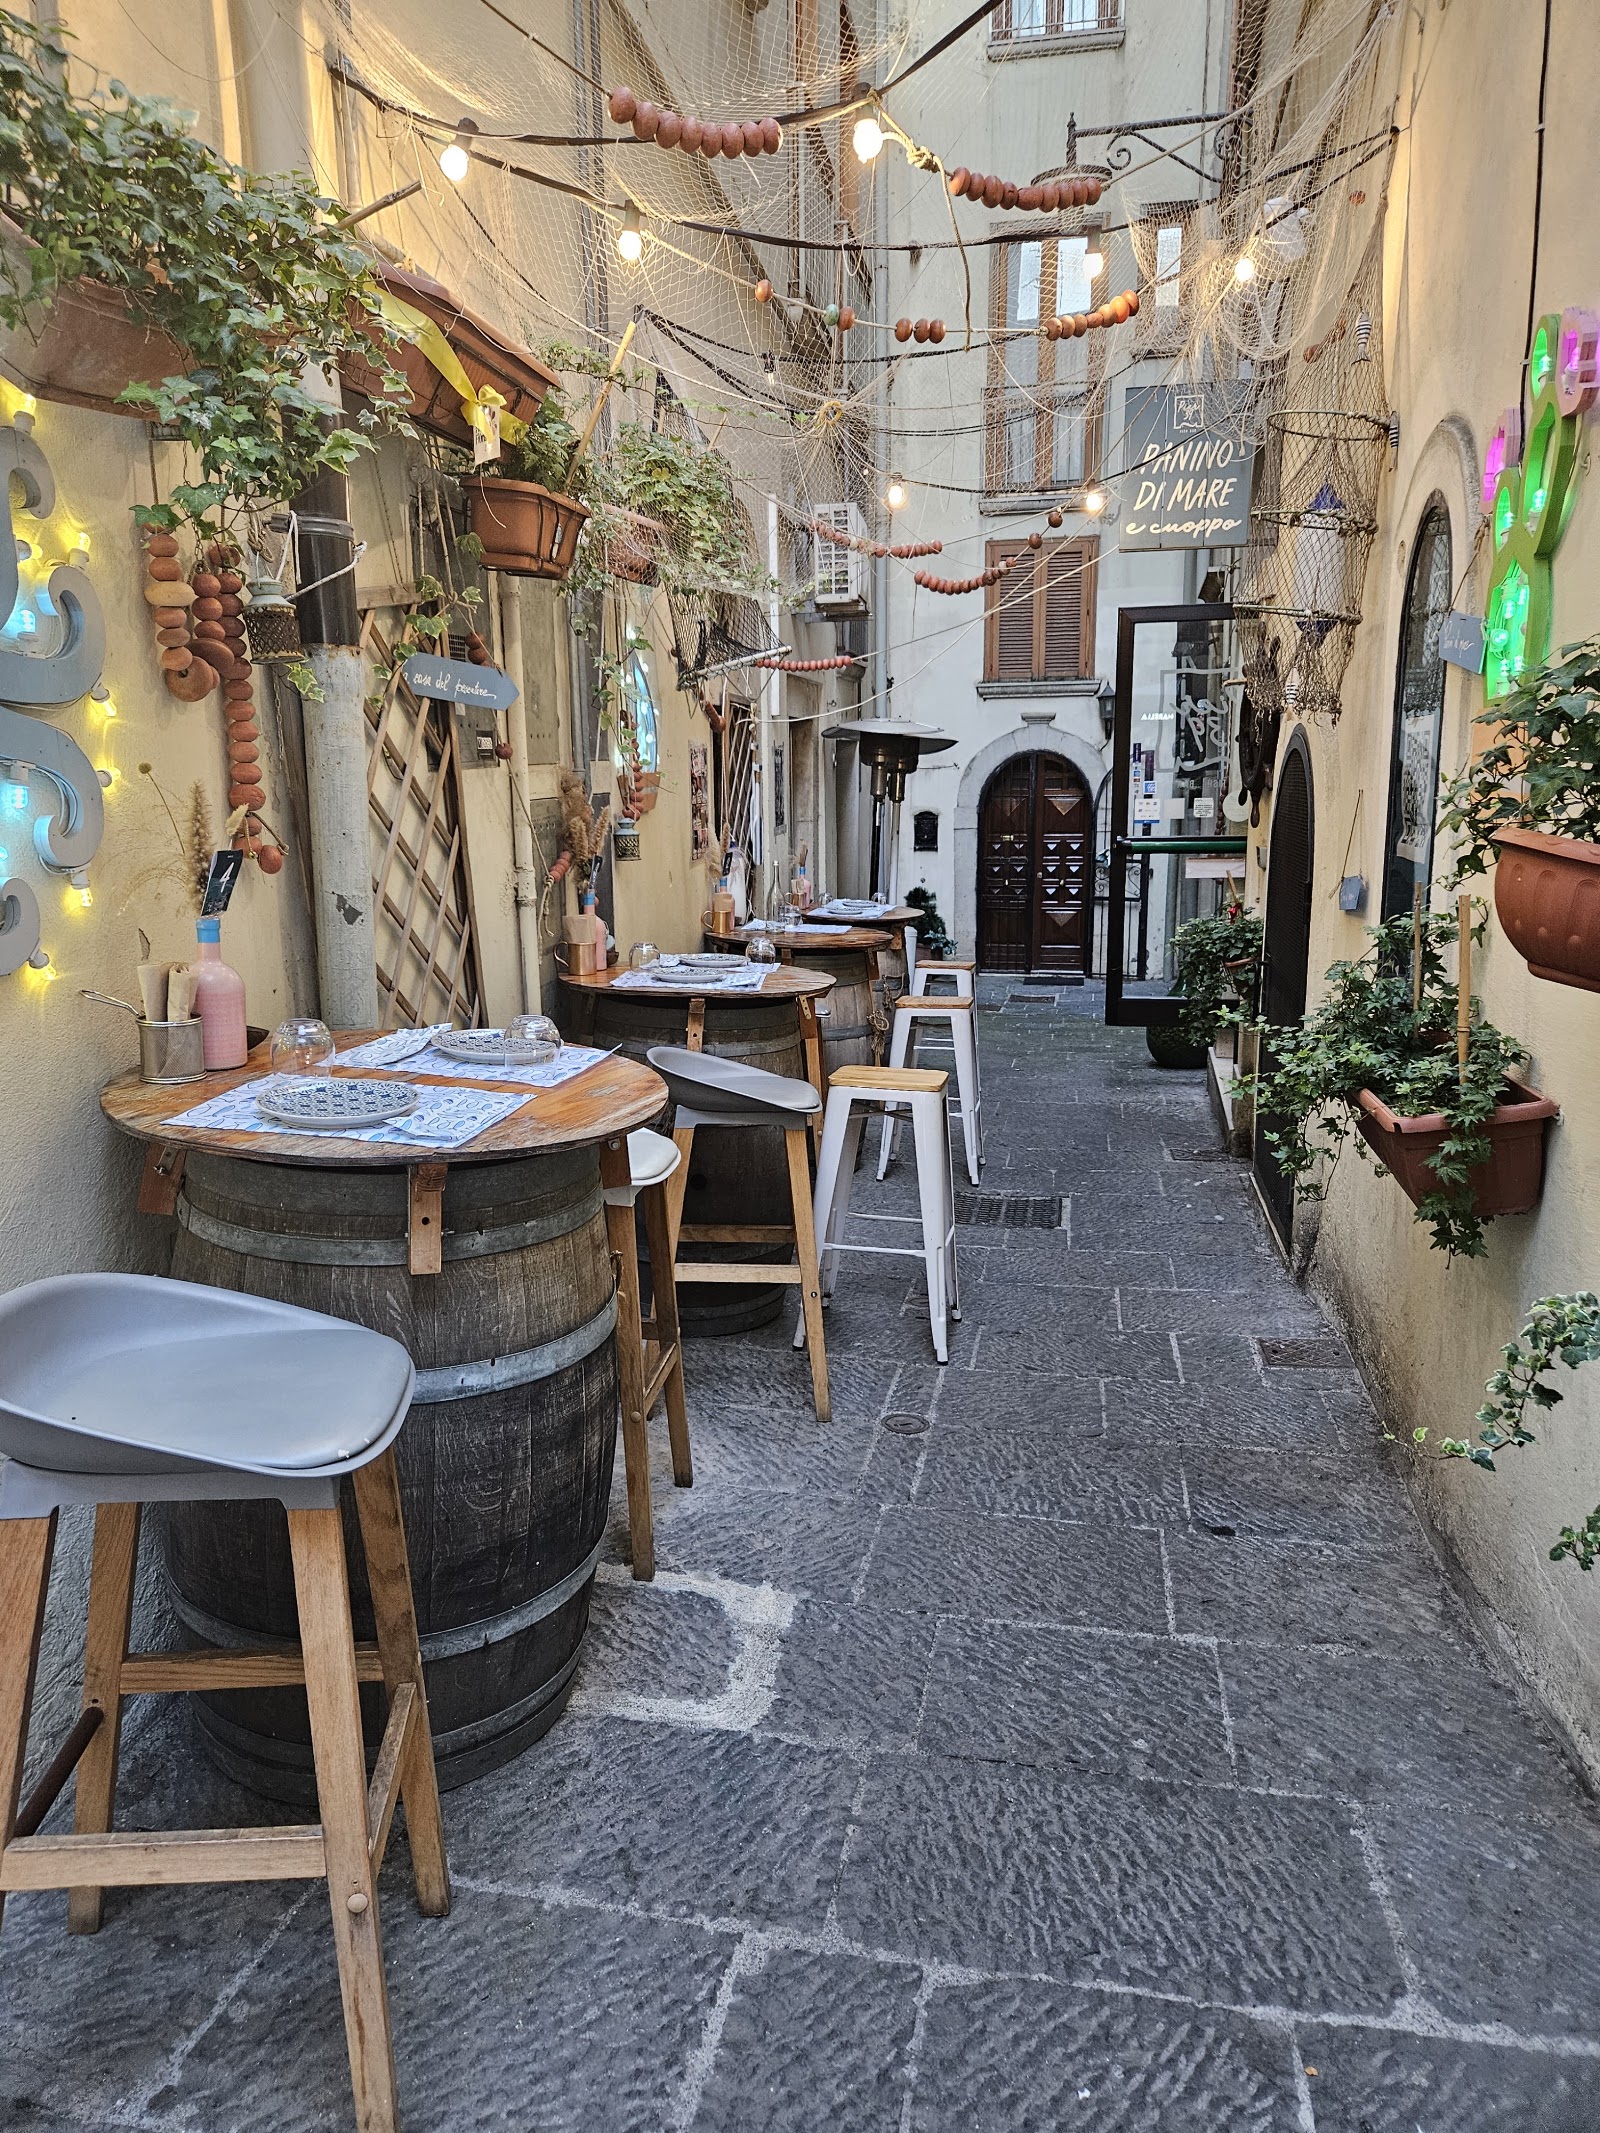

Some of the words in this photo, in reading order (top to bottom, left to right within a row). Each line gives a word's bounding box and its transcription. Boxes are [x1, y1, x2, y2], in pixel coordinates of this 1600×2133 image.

[1139, 439, 1234, 475] PANINO
[1133, 481, 1167, 511] DI
[1167, 477, 1238, 511] MARE
[1125, 522, 1146, 535] e
[1149, 517, 1242, 539] cuoppo
[413, 673, 431, 687] casa
[435, 671, 451, 692] del
[219, 861, 235, 893] 4
